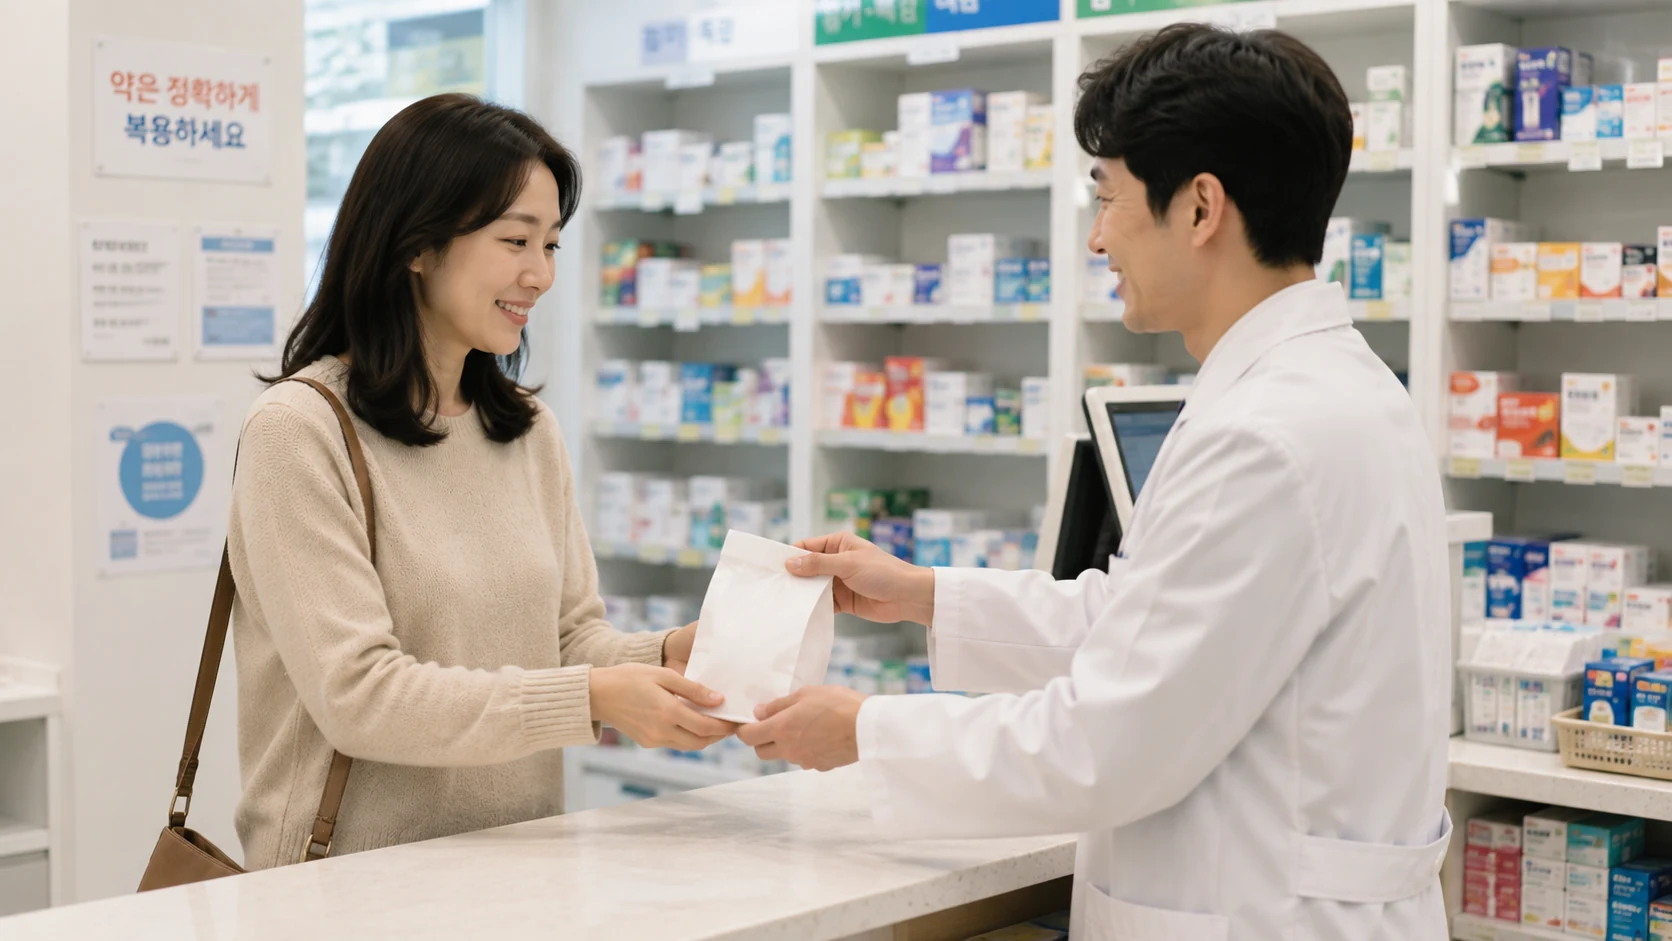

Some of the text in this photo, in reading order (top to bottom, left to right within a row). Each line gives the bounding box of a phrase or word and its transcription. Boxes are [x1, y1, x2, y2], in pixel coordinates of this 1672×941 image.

[109, 70, 260, 112] 약은 정확하게
[124, 112, 246, 149] 복용하세요
